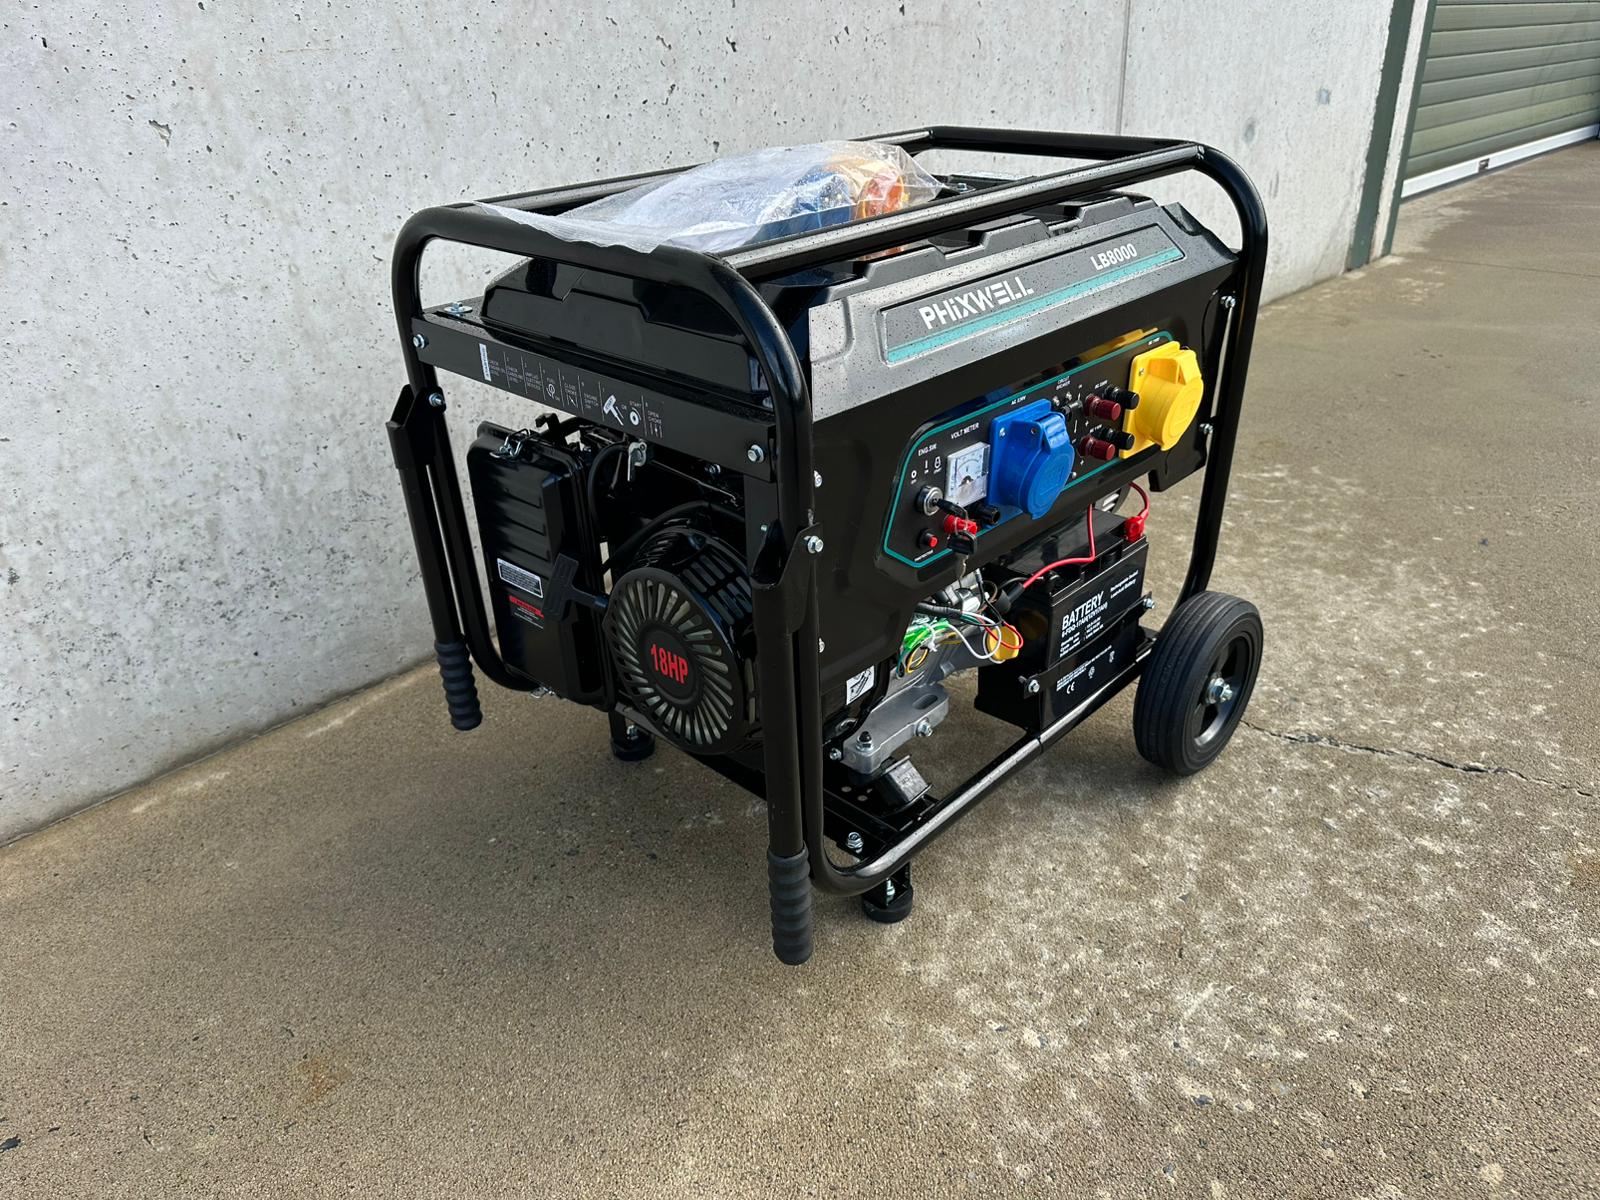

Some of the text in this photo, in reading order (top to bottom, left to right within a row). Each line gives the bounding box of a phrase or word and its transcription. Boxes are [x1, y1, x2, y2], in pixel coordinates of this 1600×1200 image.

[1090, 243, 1138, 271] LB8000
[951, 422, 979, 439] VOLT METER
[1062, 590, 1104, 631] BATTERY
[650, 643, 689, 684] 18HP
